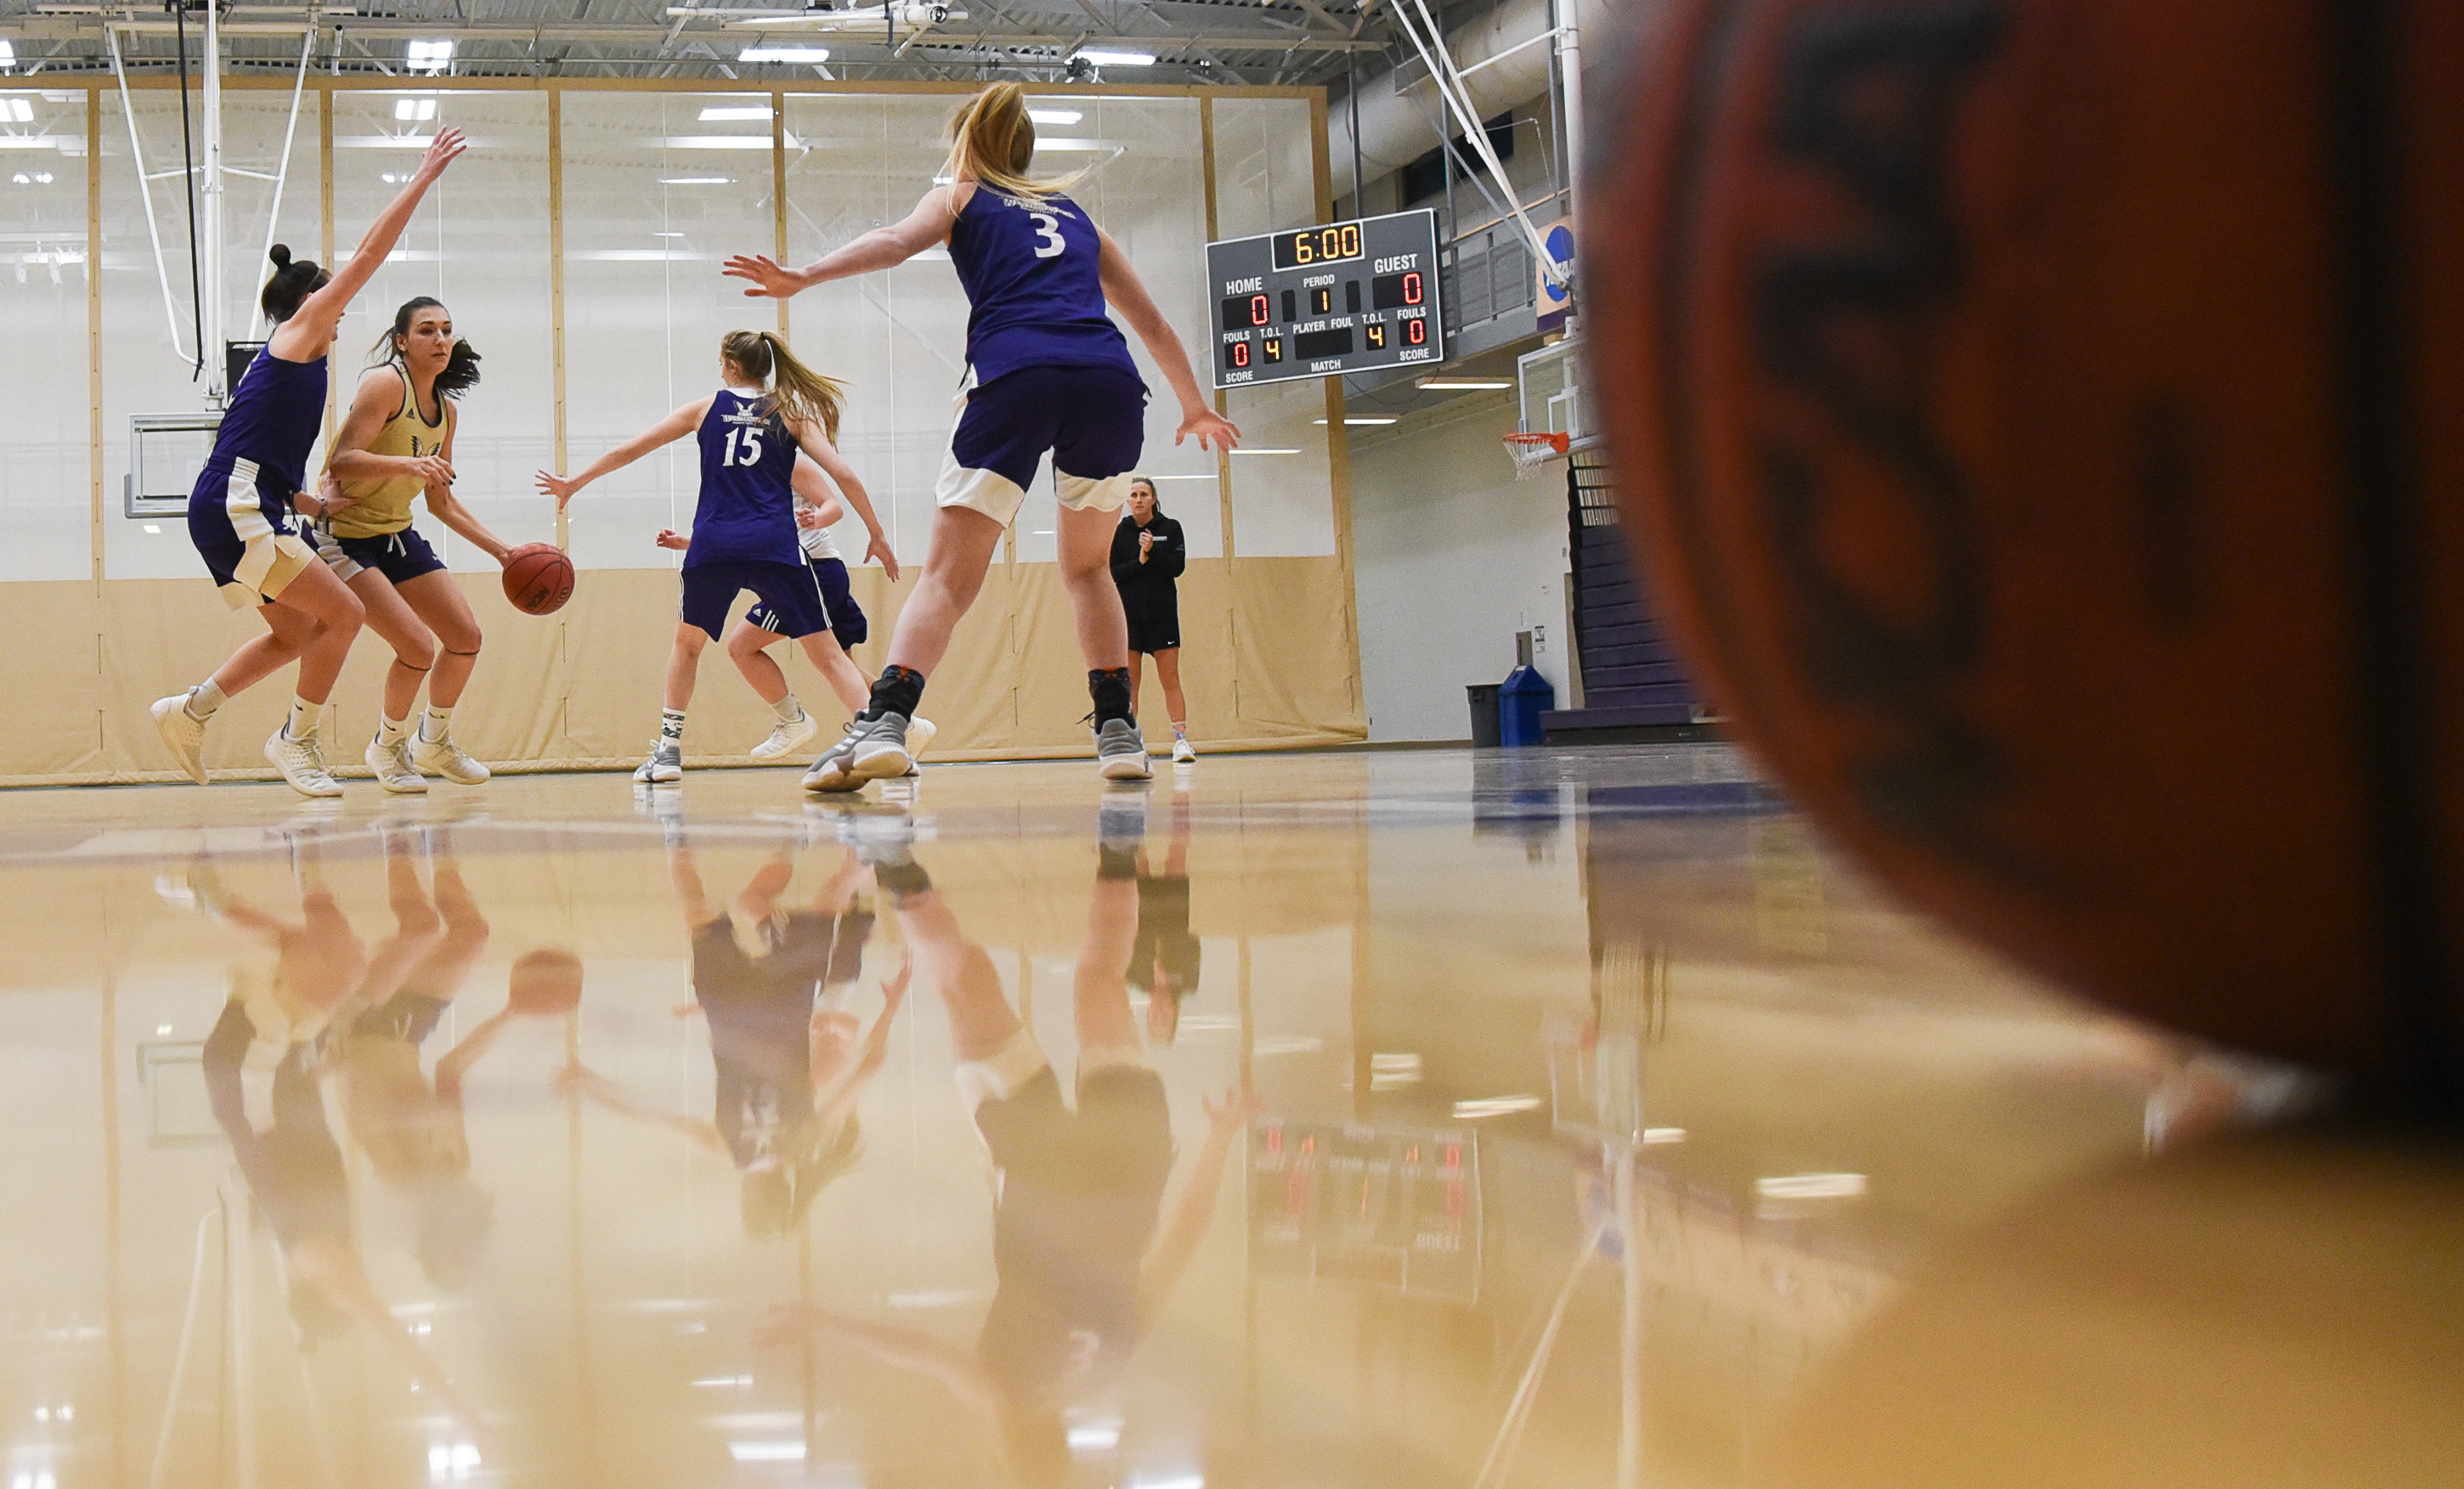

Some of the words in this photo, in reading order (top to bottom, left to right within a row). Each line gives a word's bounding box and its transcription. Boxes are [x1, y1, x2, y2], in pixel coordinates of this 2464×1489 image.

[1030, 212, 1065, 258] 3
[1296, 225, 1359, 264] 6:00
[1374, 254, 1417, 274] GUEST
[1226, 276, 1263, 295] HOME
[1303, 274, 1335, 288] PERIOD
[1404, 272, 1421, 304] 0
[1251, 295, 1269, 325] 0
[1321, 290, 1328, 311] 1
[1362, 313, 1387, 324] T.O.L.
[1397, 307, 1426, 320] FOULS
[1259, 326, 1284, 338] T.O.L.
[1293, 320, 1325, 334] PLAYER
[1331, 317, 1354, 329] FOUL
[1410, 319, 1424, 343] 0
[1224, 330, 1251, 343] FOULS
[1369, 326, 1382, 347] 4
[1235, 343, 1248, 366] 0
[1266, 340, 1280, 360] 4
[1399, 348, 1429, 361] SCORE
[1311, 359, 1341, 372] MATCH
[1225, 370, 1253, 383] SCORE
[722, 426, 764, 466] 15
